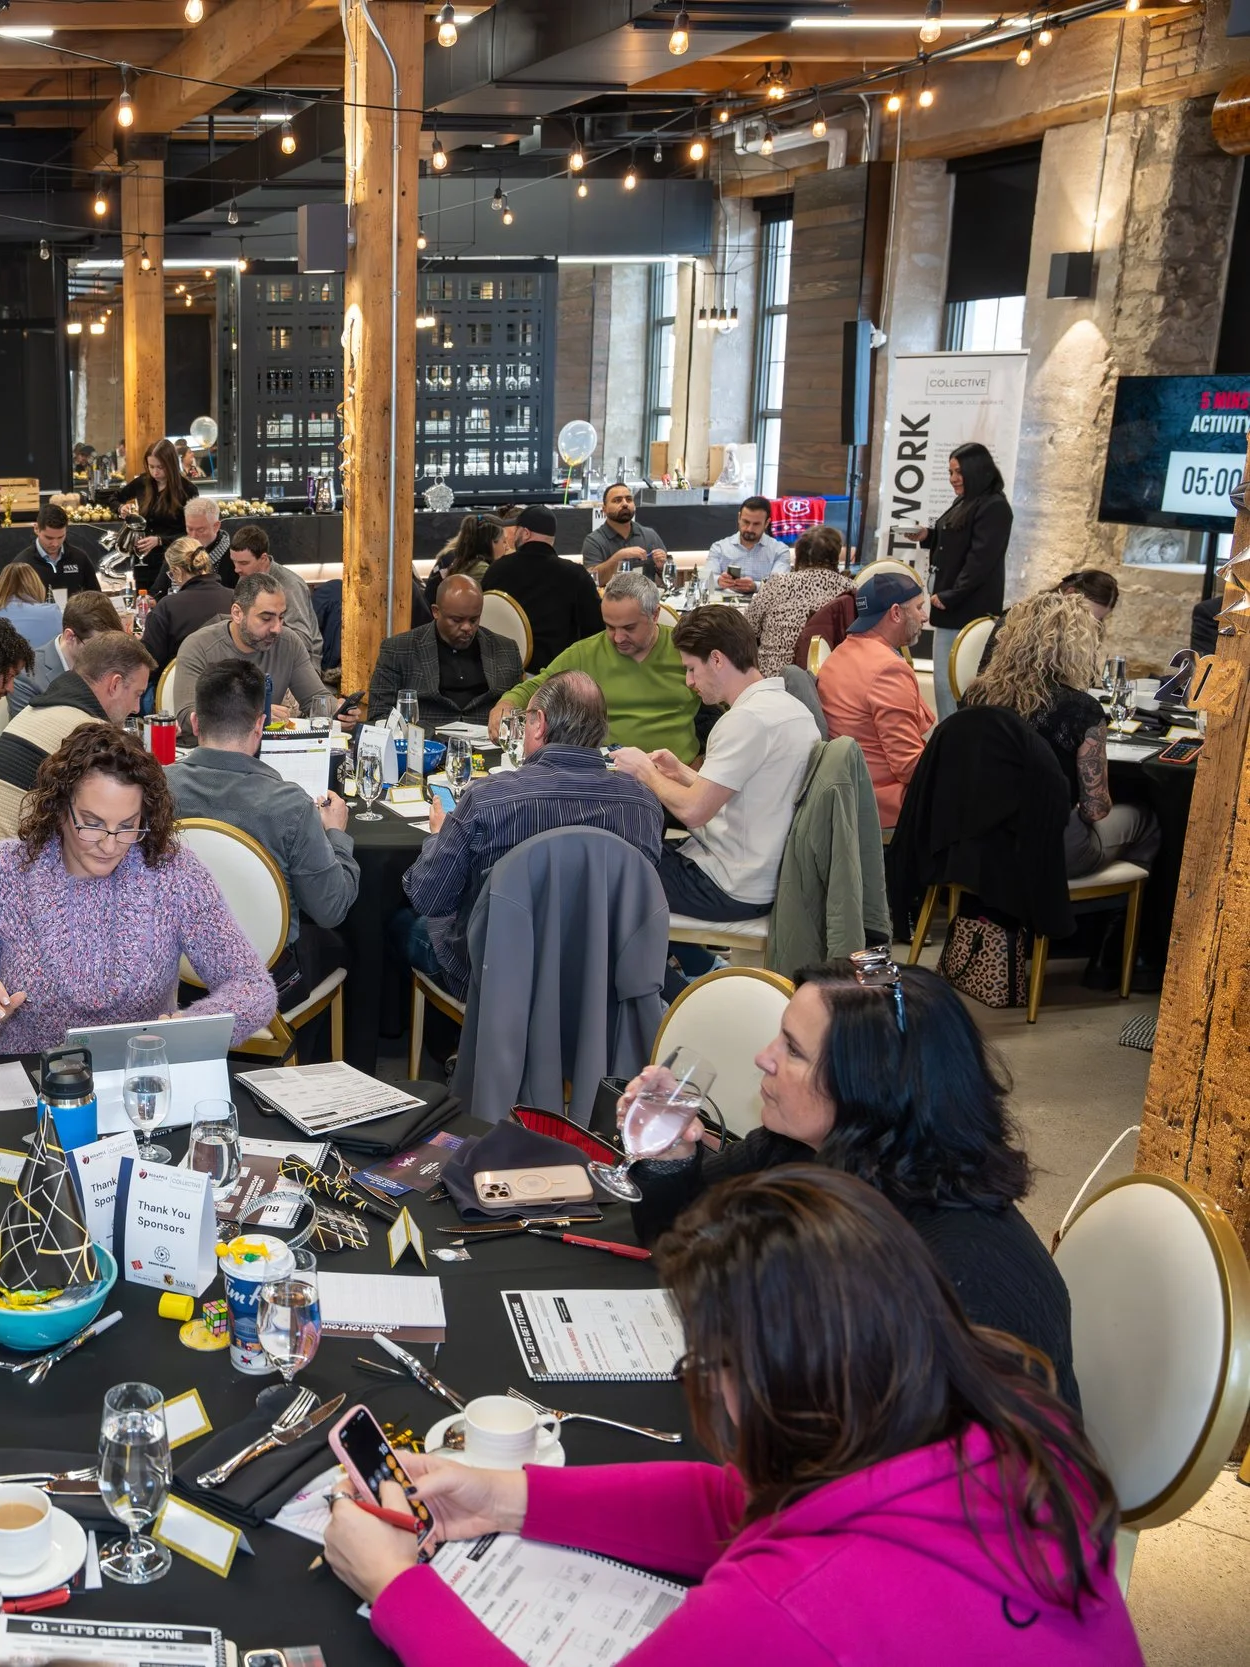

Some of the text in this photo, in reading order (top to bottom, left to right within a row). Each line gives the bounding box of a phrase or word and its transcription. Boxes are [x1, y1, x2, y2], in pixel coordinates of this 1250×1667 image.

[929, 378, 987, 388] COLLECTIVE
[1200, 390, 1250, 410] 5 MINS
[1190, 415, 1250, 433] ACTIVITY
[887, 413, 931, 562] TWORK
[1182, 466, 1243, 496] 05:00
[91, 1177, 117, 1193] Thank
[94, 1194, 117, 1208] Spon
[138, 1200, 191, 1220] Thank You
[137, 1216, 186, 1235] Sponsors
[30, 1621, 49, 1632] Q1
[59, 1623, 95, 1636] LET'S
[96, 1625, 123, 1638] GET
[126, 1628, 143, 1638] IT
[144, 1628, 183, 1640] DONE
